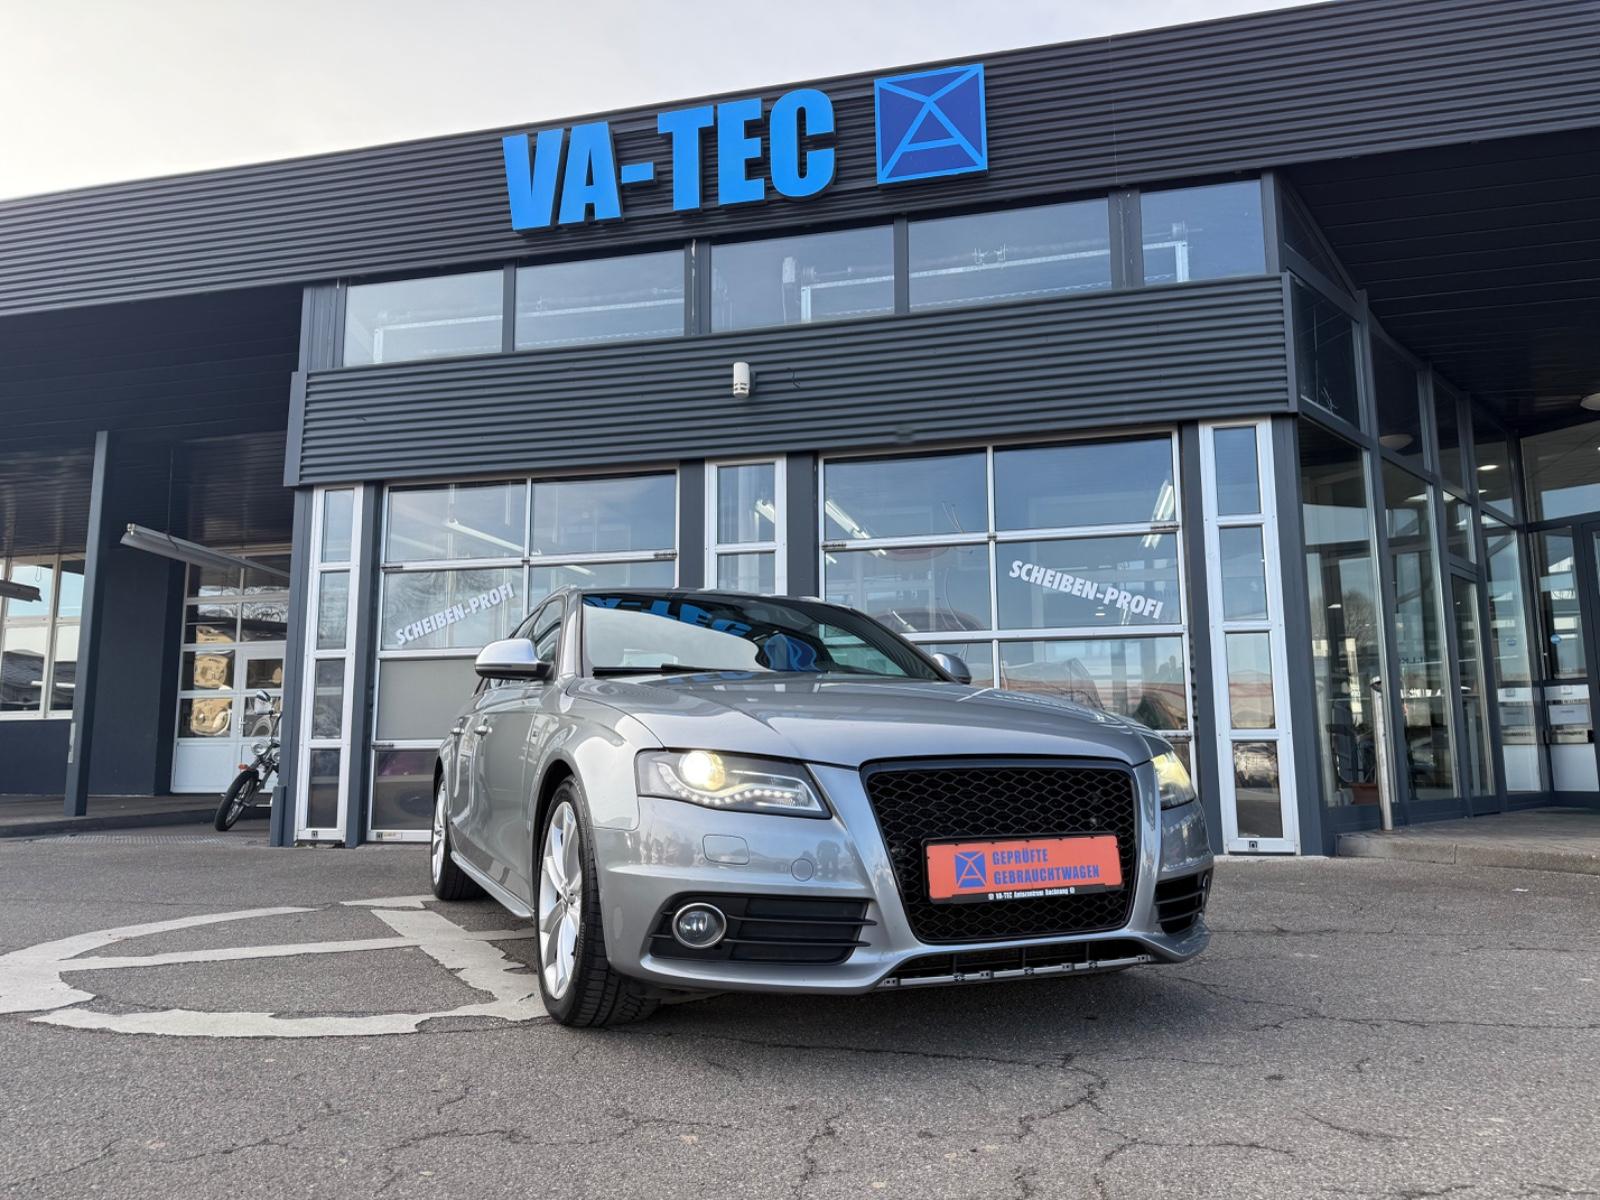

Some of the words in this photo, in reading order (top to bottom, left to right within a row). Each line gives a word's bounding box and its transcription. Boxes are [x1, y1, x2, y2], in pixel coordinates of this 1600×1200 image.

[502, 89, 836, 231] VA-TEC
[395, 582, 515, 646] SCHEIBEN-PROFI
[1009, 560, 1164, 620] SCHEIBEN-PROFI
[992, 848, 1048, 865] GEPRÜFTE
[994, 865, 1100, 885] GEBRAUCHTWAGEN
